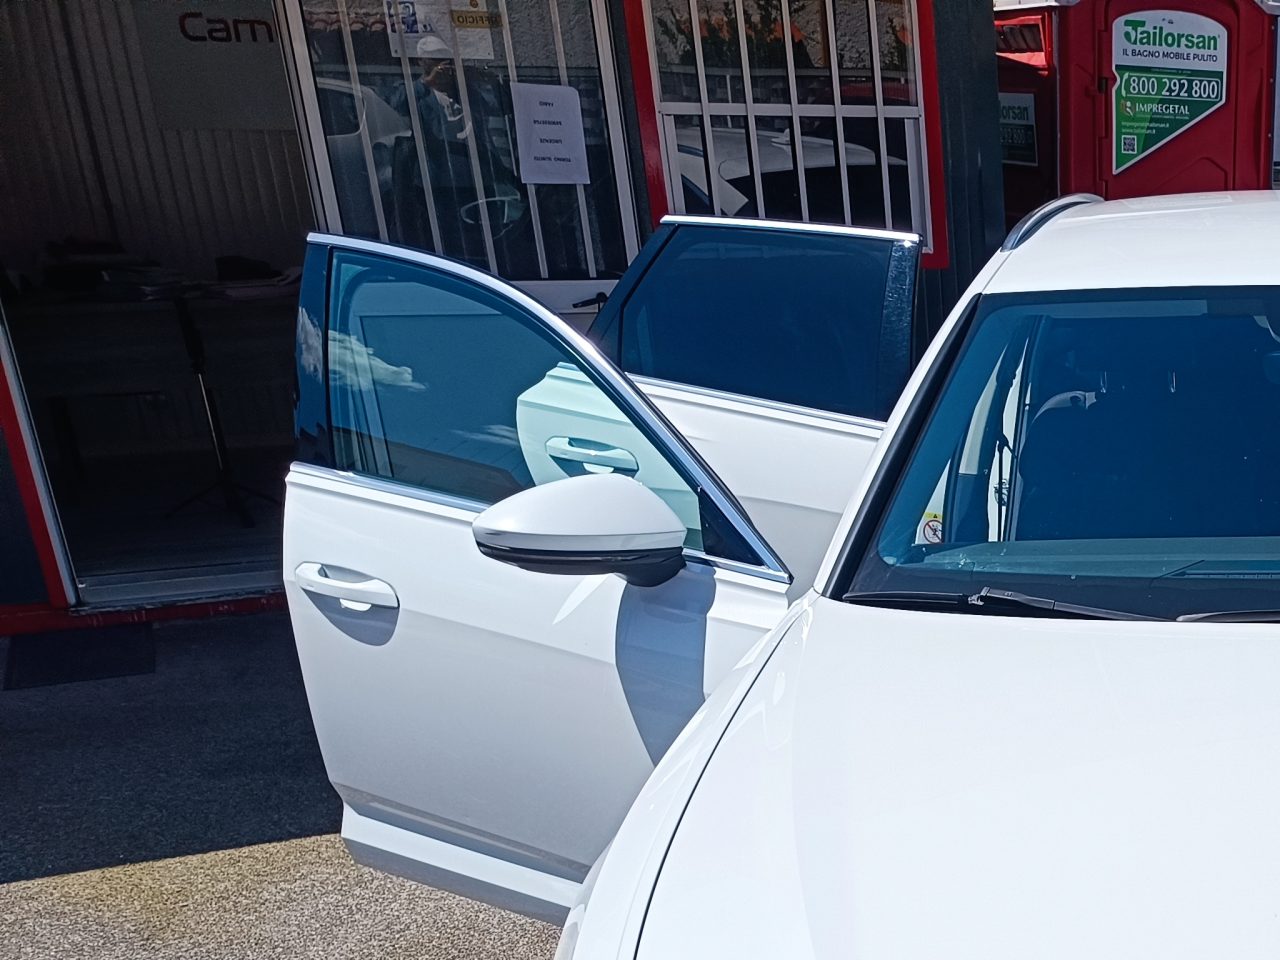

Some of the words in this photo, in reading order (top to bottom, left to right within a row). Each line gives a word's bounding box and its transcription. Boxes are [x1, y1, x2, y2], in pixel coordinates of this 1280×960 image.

[1123, 19, 1218, 51] Tailorsan
[1122, 48, 1129, 56] IL
[1131, 49, 1160, 59] BAGNO
[1162, 51, 1191, 61] MOBILE
[1192, 53, 1218, 62] PULITO
[1129, 76, 1157, 95] 800
[1161, 78, 1188, 97] 292
[1191, 80, 1218, 98] 800
[1136, 103, 1190, 115] IMPREGETAL
